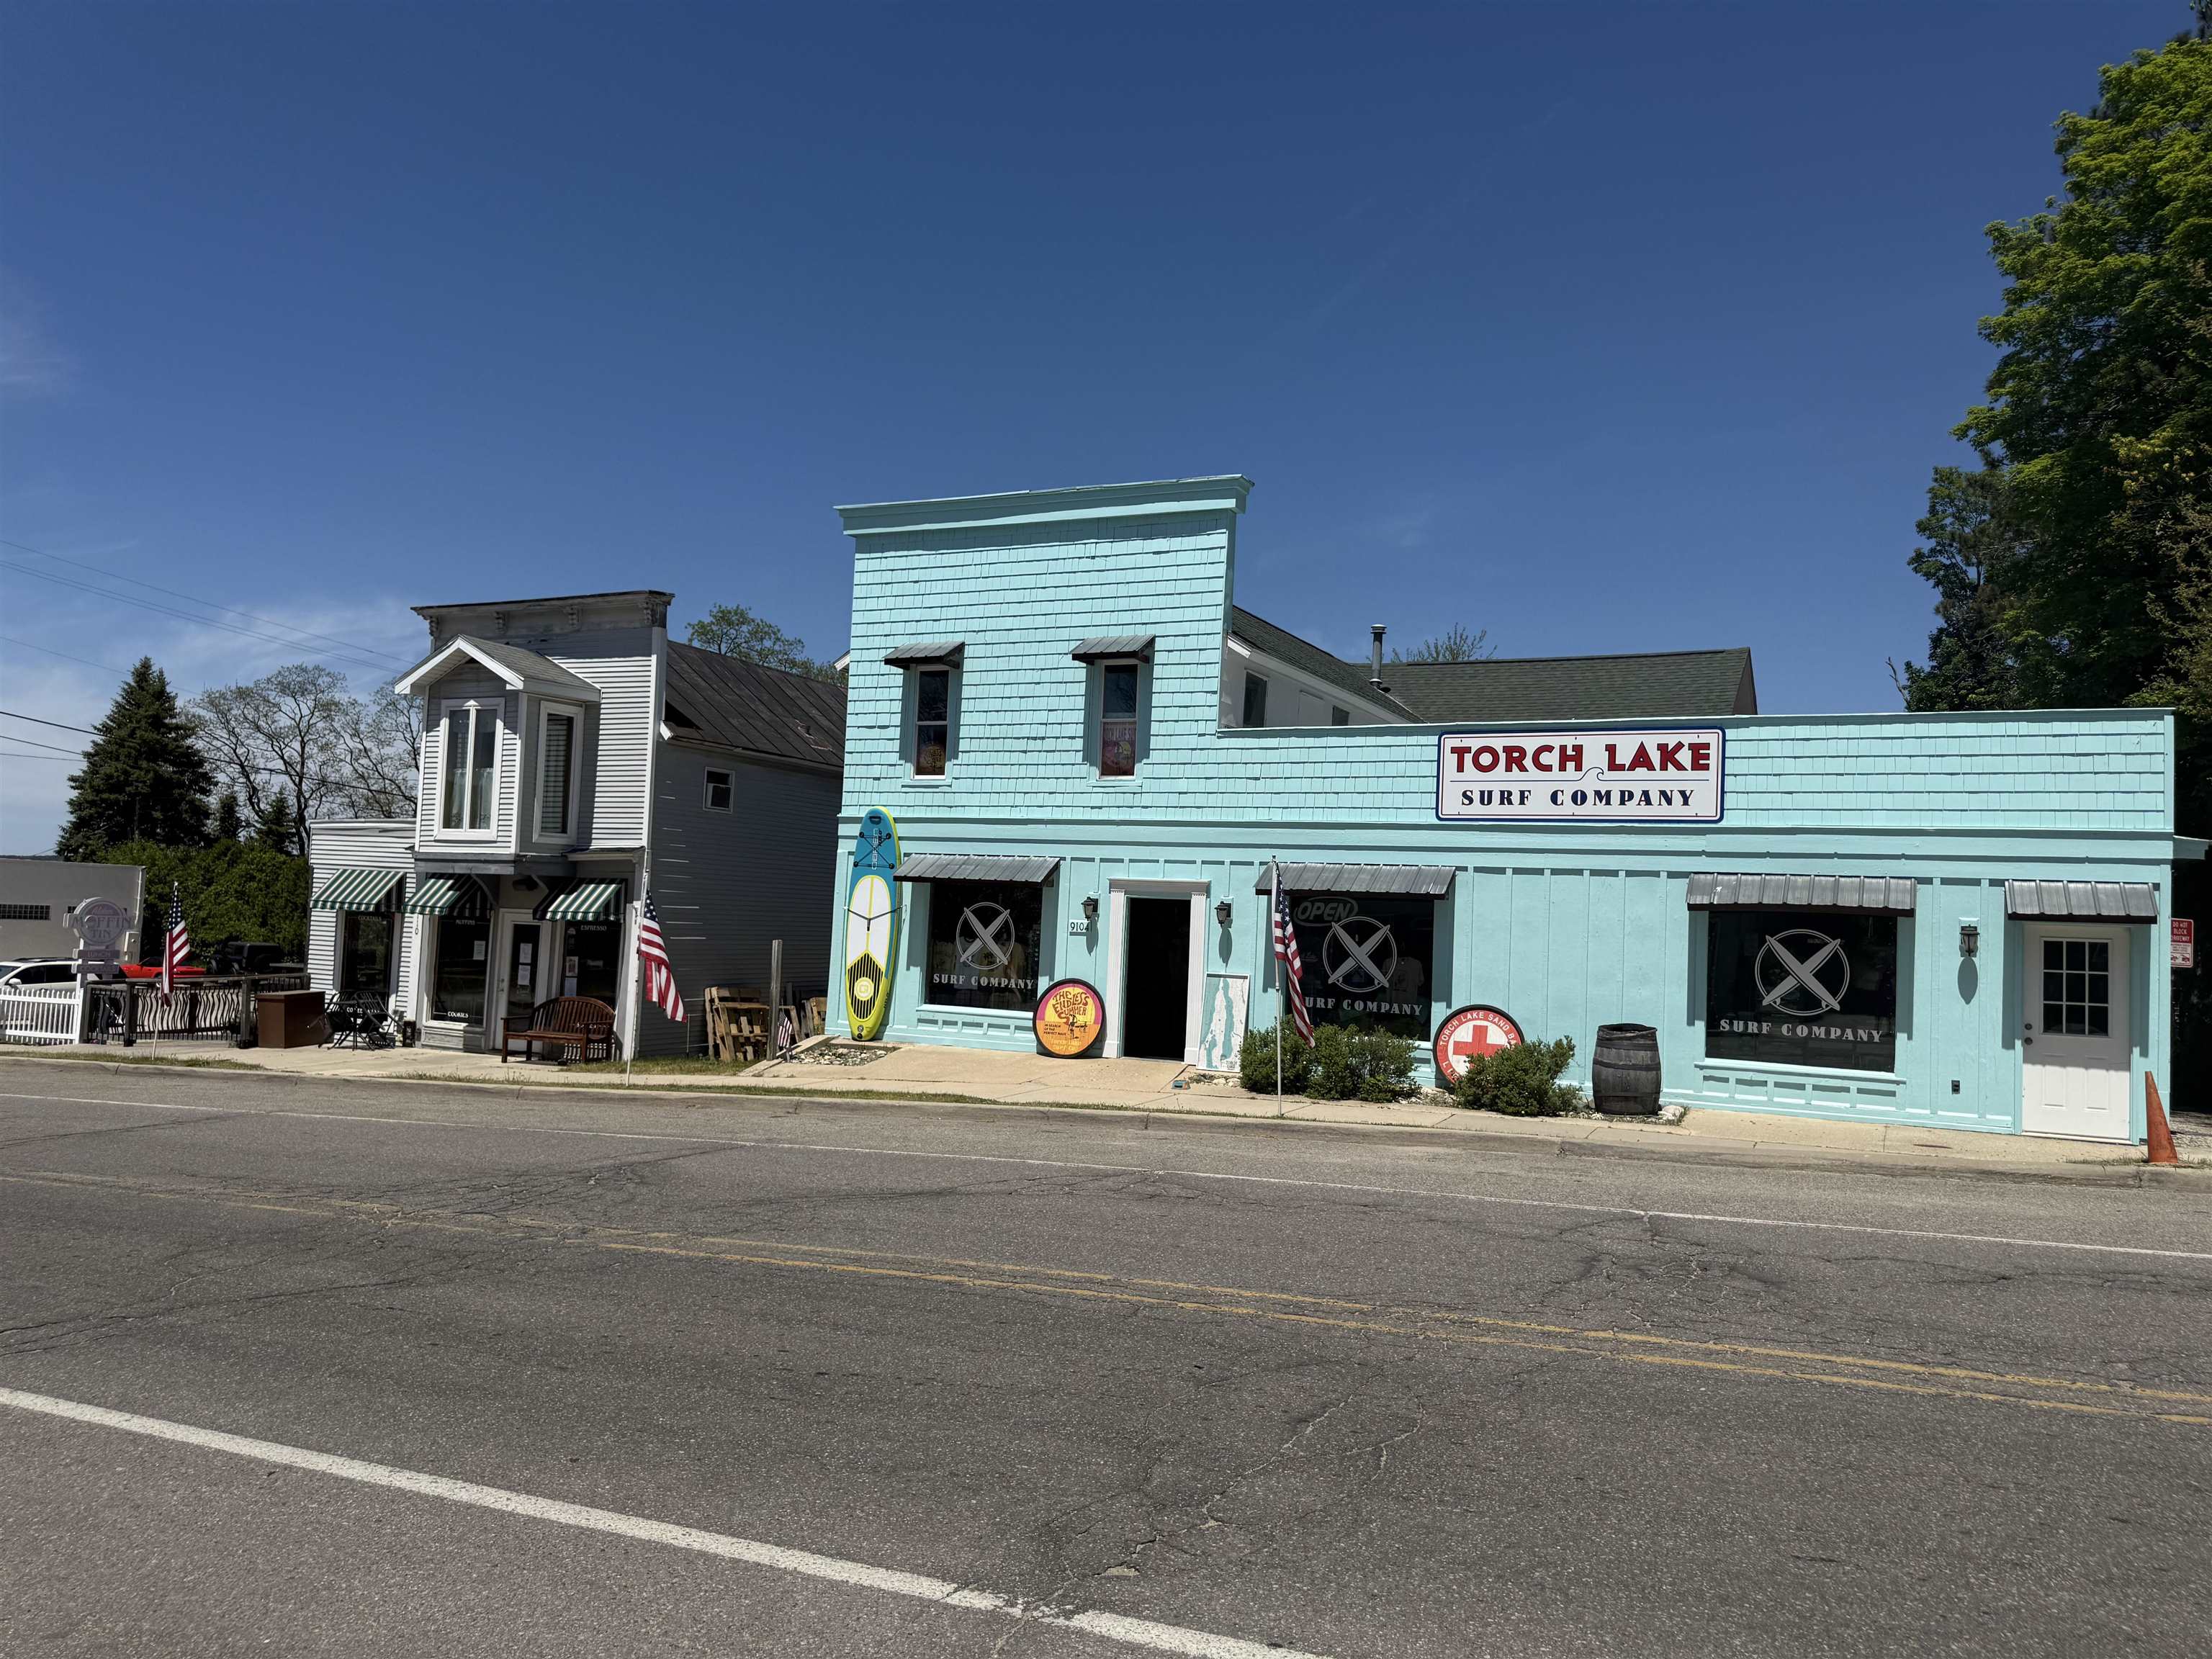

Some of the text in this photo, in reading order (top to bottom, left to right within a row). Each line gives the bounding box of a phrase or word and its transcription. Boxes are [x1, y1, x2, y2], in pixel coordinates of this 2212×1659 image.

[1450, 740, 1710, 773] TORCH LAKE
[1461, 789, 1694, 806] SURF COMPANY
[1298, 902, 1352, 921] OPEN
[91, 929, 111, 939] TIN
[1070, 922, 1089, 931] 9104
[933, 974, 1034, 989] SURF COMPANY
[1053, 991, 1072, 1003] THE
[1304, 997, 1423, 1015] URF COMPANY
[1058, 1006, 1087, 1025] SUMMER
[1440, 1019, 1460, 1047] TORCH
[1460, 1012, 1484, 1022] LAKE
[1488, 1014, 1509, 1031] SAND
[1720, 1019, 1882, 1043] SURF COMPANY
